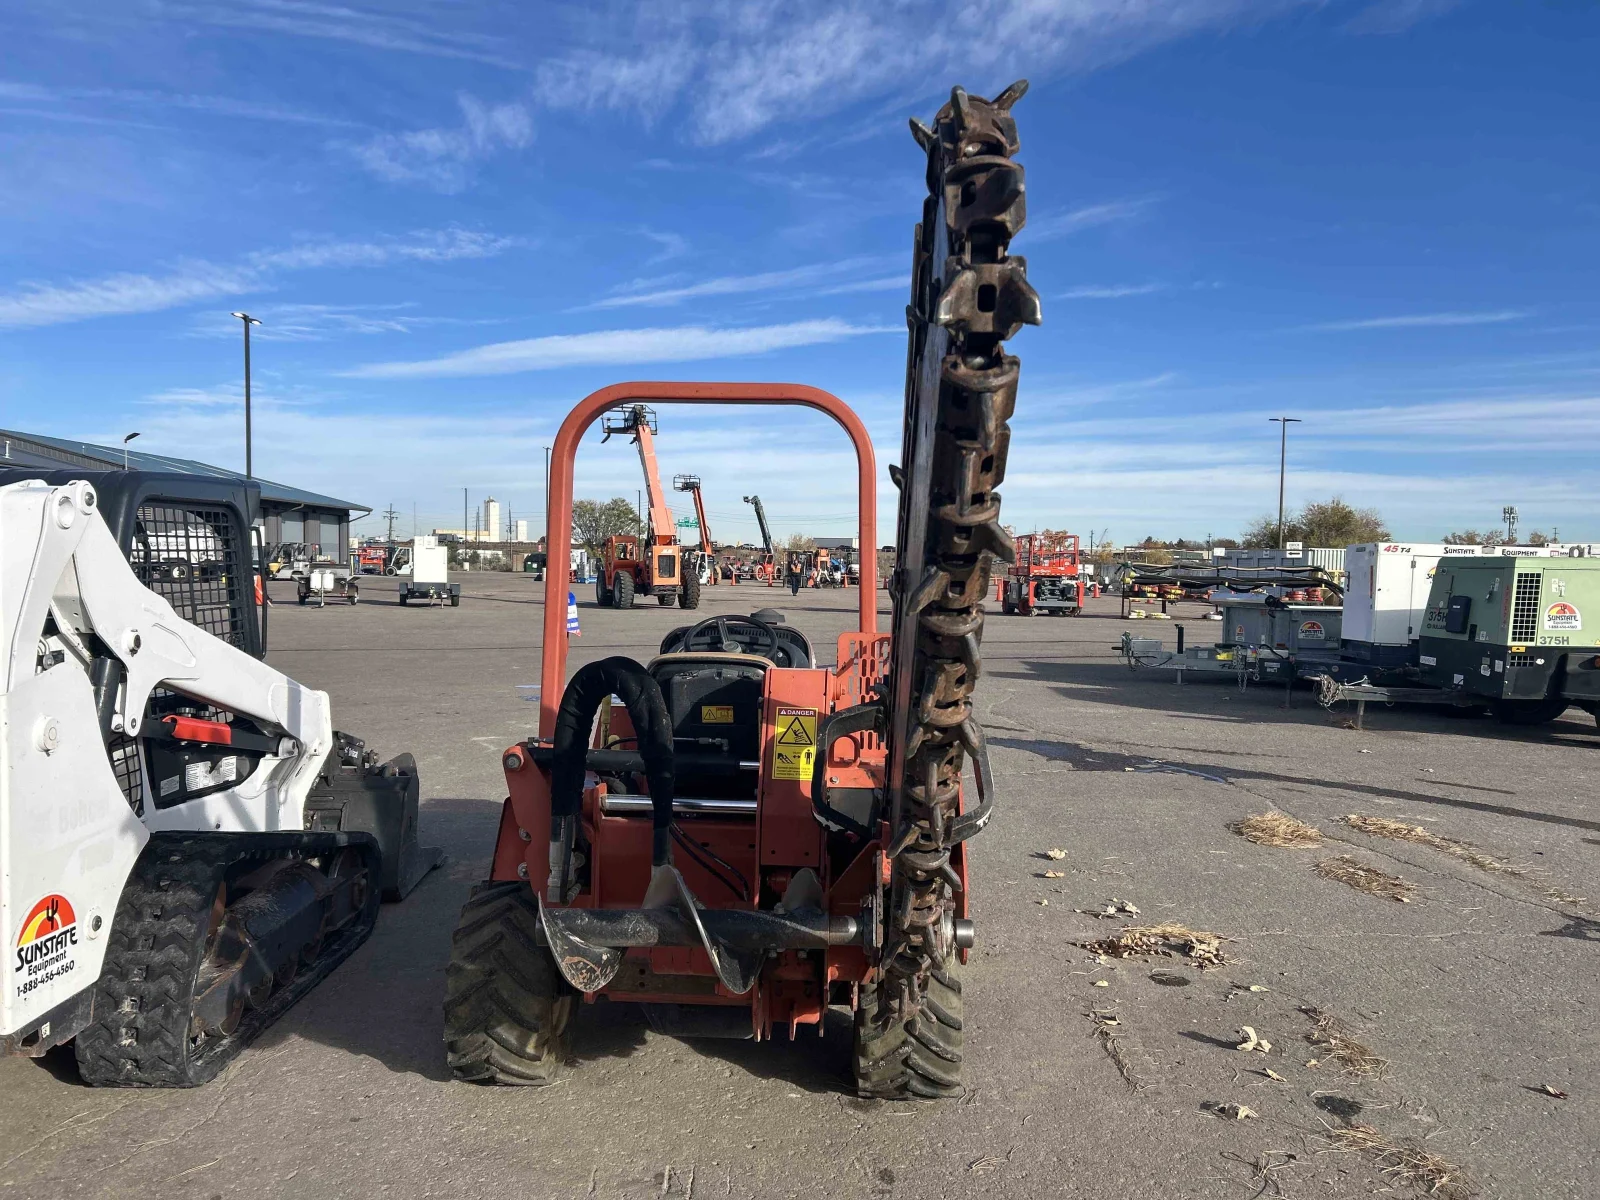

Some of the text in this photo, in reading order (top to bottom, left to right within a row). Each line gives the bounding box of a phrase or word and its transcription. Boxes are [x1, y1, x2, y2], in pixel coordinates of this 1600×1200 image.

[1384, 545, 1399, 553] 45
[1444, 547, 1538, 557] SUNSTATE EQUIPMENT
[1547, 614, 1578, 622] SUNSTATE
[1540, 636, 1570, 645] 375H
[15, 926, 78, 973] SUNSTATE
[28, 950, 67, 977] Equipment
[16, 960, 75, 998] 1-888-456-4560
